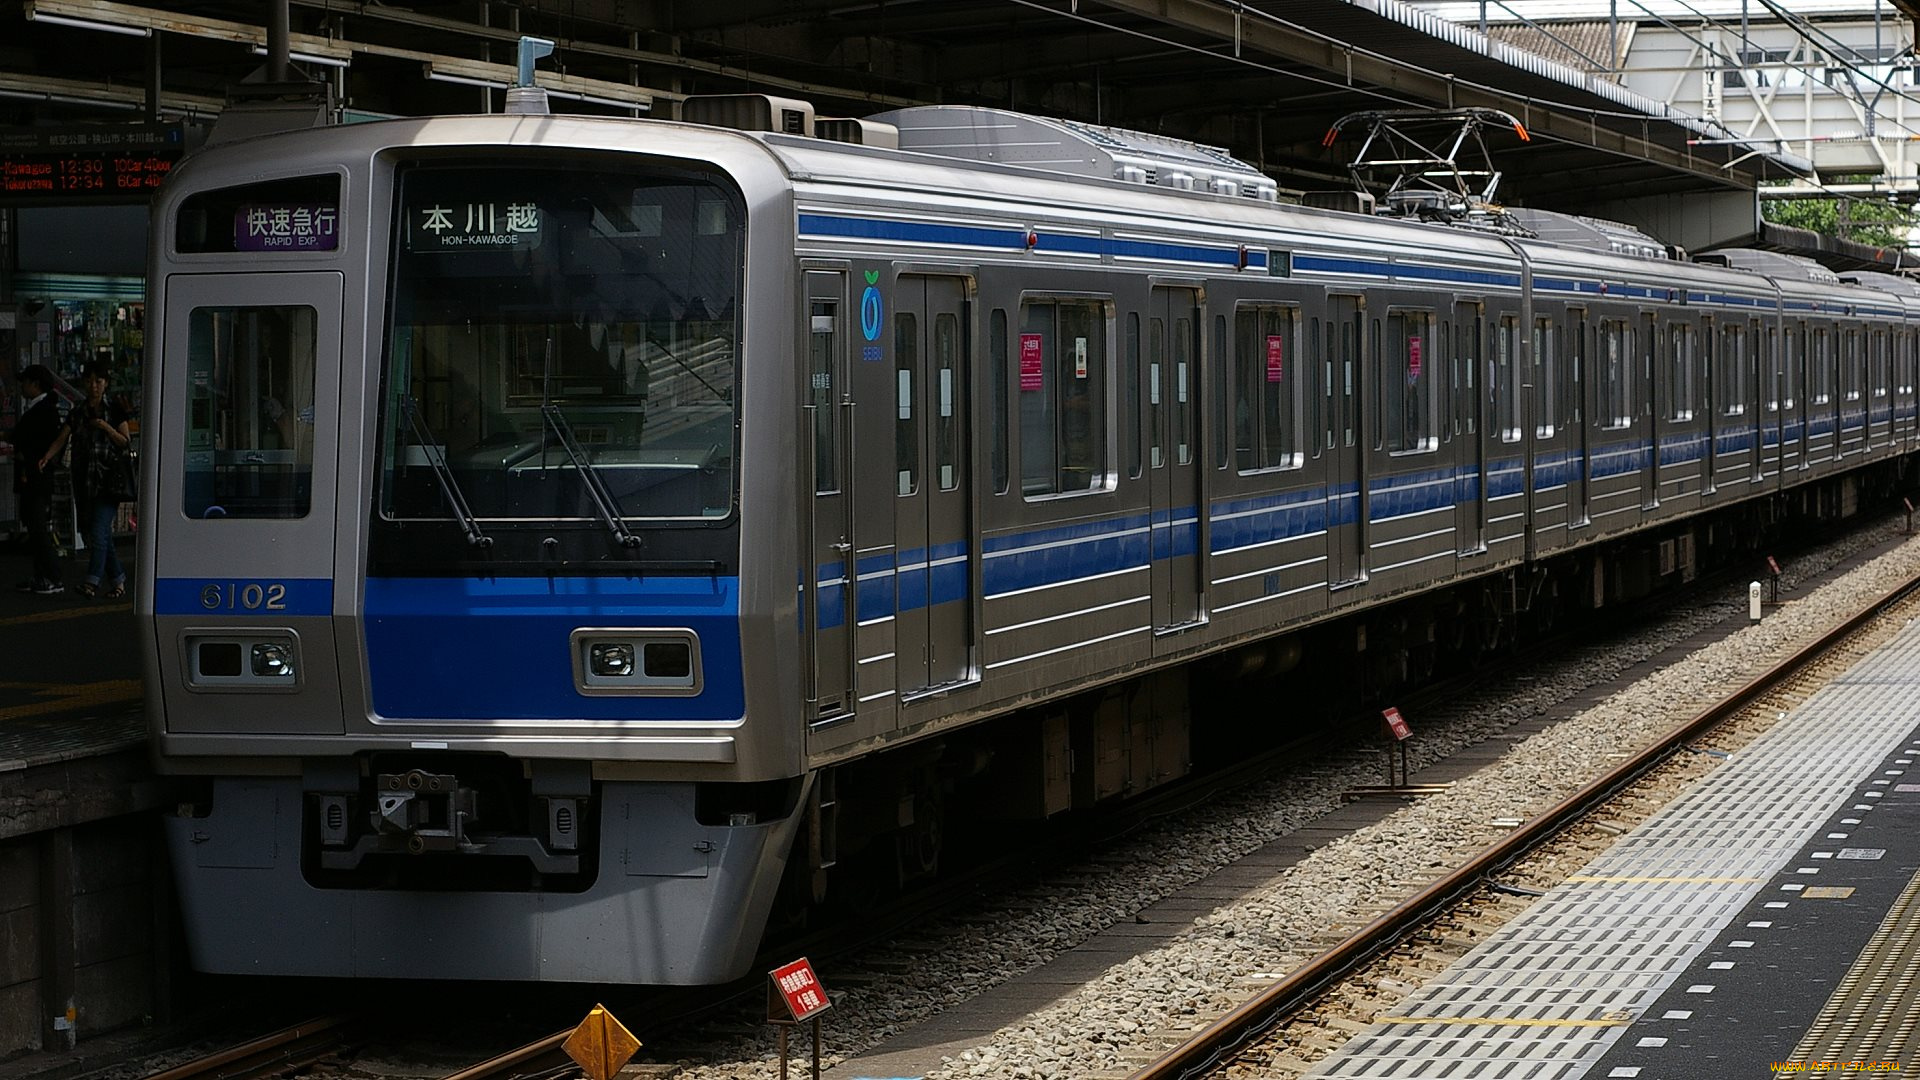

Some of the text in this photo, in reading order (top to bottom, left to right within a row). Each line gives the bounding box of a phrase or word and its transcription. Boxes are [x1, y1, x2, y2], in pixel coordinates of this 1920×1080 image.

[172, 131, 177, 142] 1
[59, 159, 104, 174] 12:30
[60, 175, 104, 189] 12:34
[247, 207, 336, 237] 快速急行
[421, 202, 539, 235] 本川越
[264, 237, 319, 246] RAPID EXP.
[441, 234, 519, 245] HON-KAWAGOE
[863, 346, 883, 360] SEIBU
[200, 583, 287, 610] 6102
[1752, 590, 1759, 598] 9
